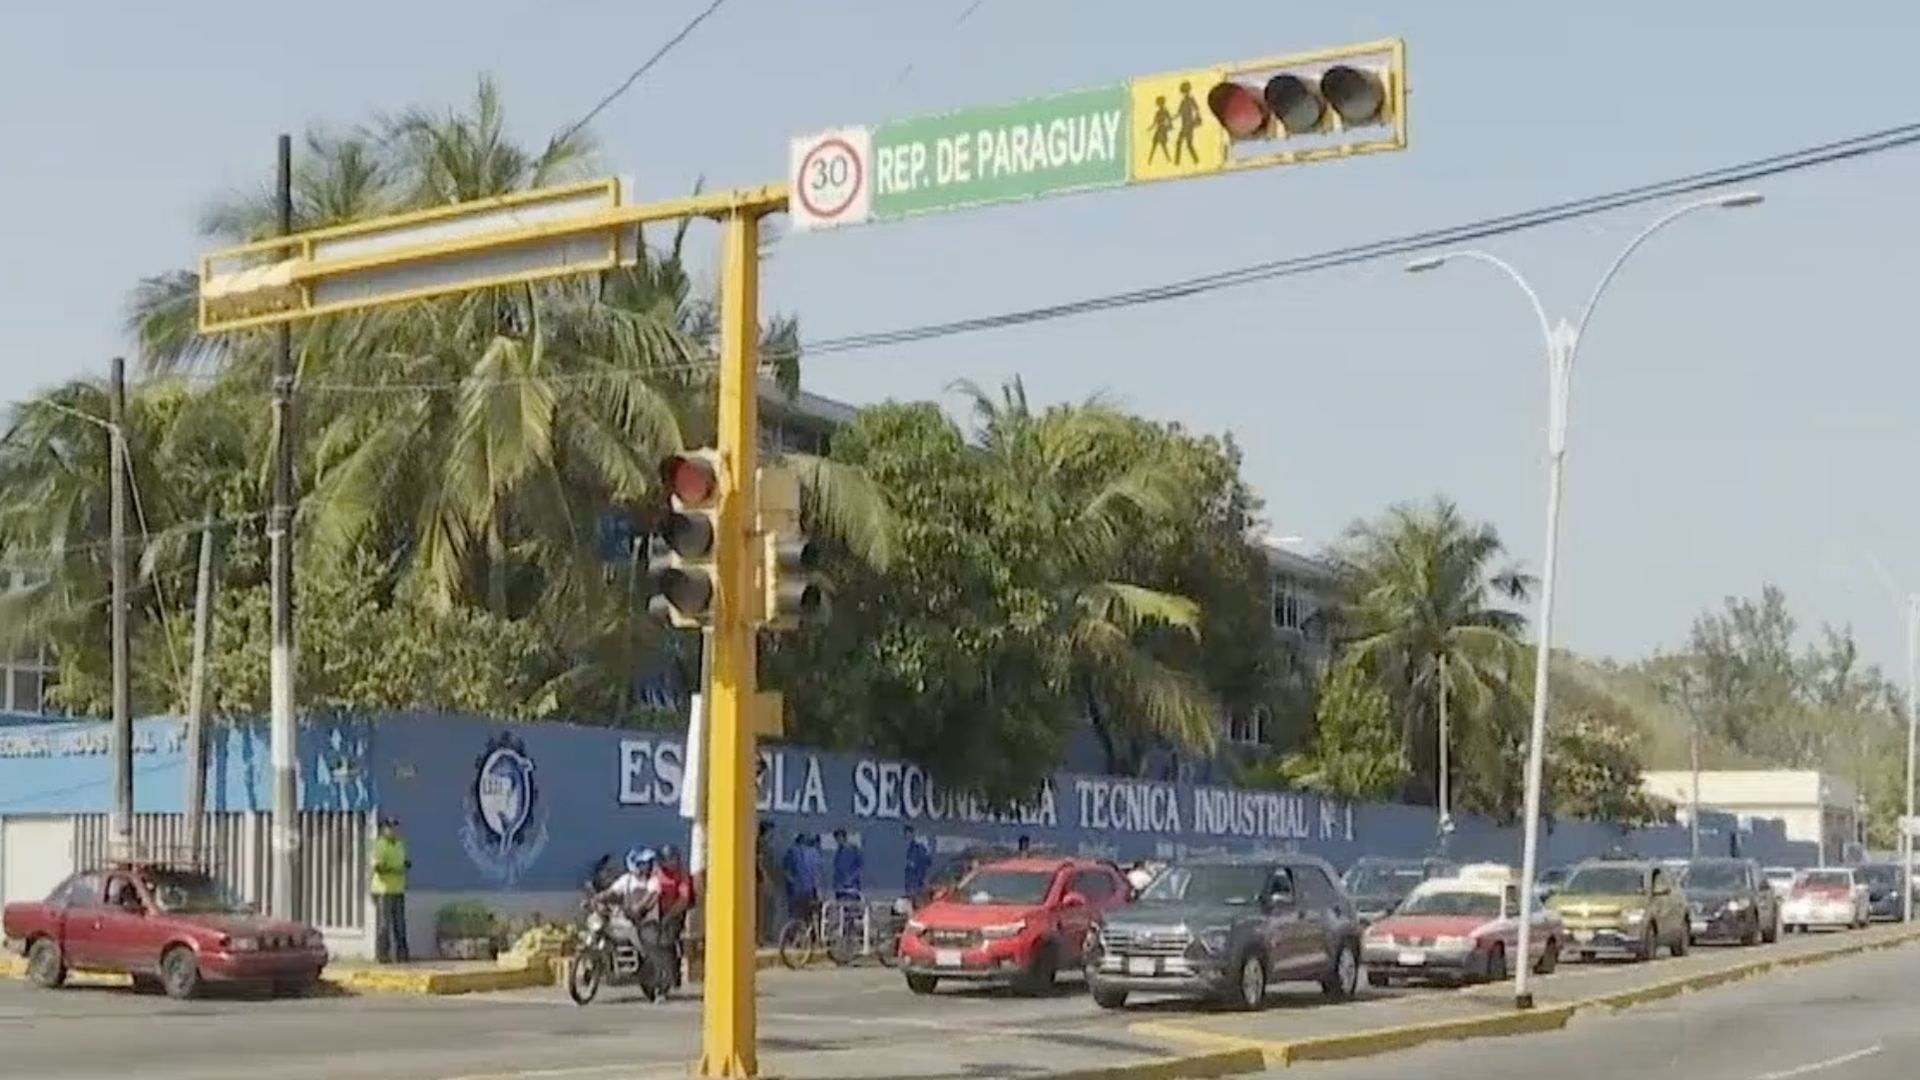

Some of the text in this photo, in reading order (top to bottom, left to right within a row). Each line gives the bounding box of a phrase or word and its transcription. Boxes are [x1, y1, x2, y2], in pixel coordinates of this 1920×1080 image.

[811, 155, 848, 190] 30
[877, 110, 1122, 194] REP. DE PARAGUAY
[619, 740, 828, 814] ESLA
[853, 759, 1058, 827] SECUNA
[1075, 780, 1181, 834] TECNICA
[1194, 788, 1310, 839] INDUSTRIAL
